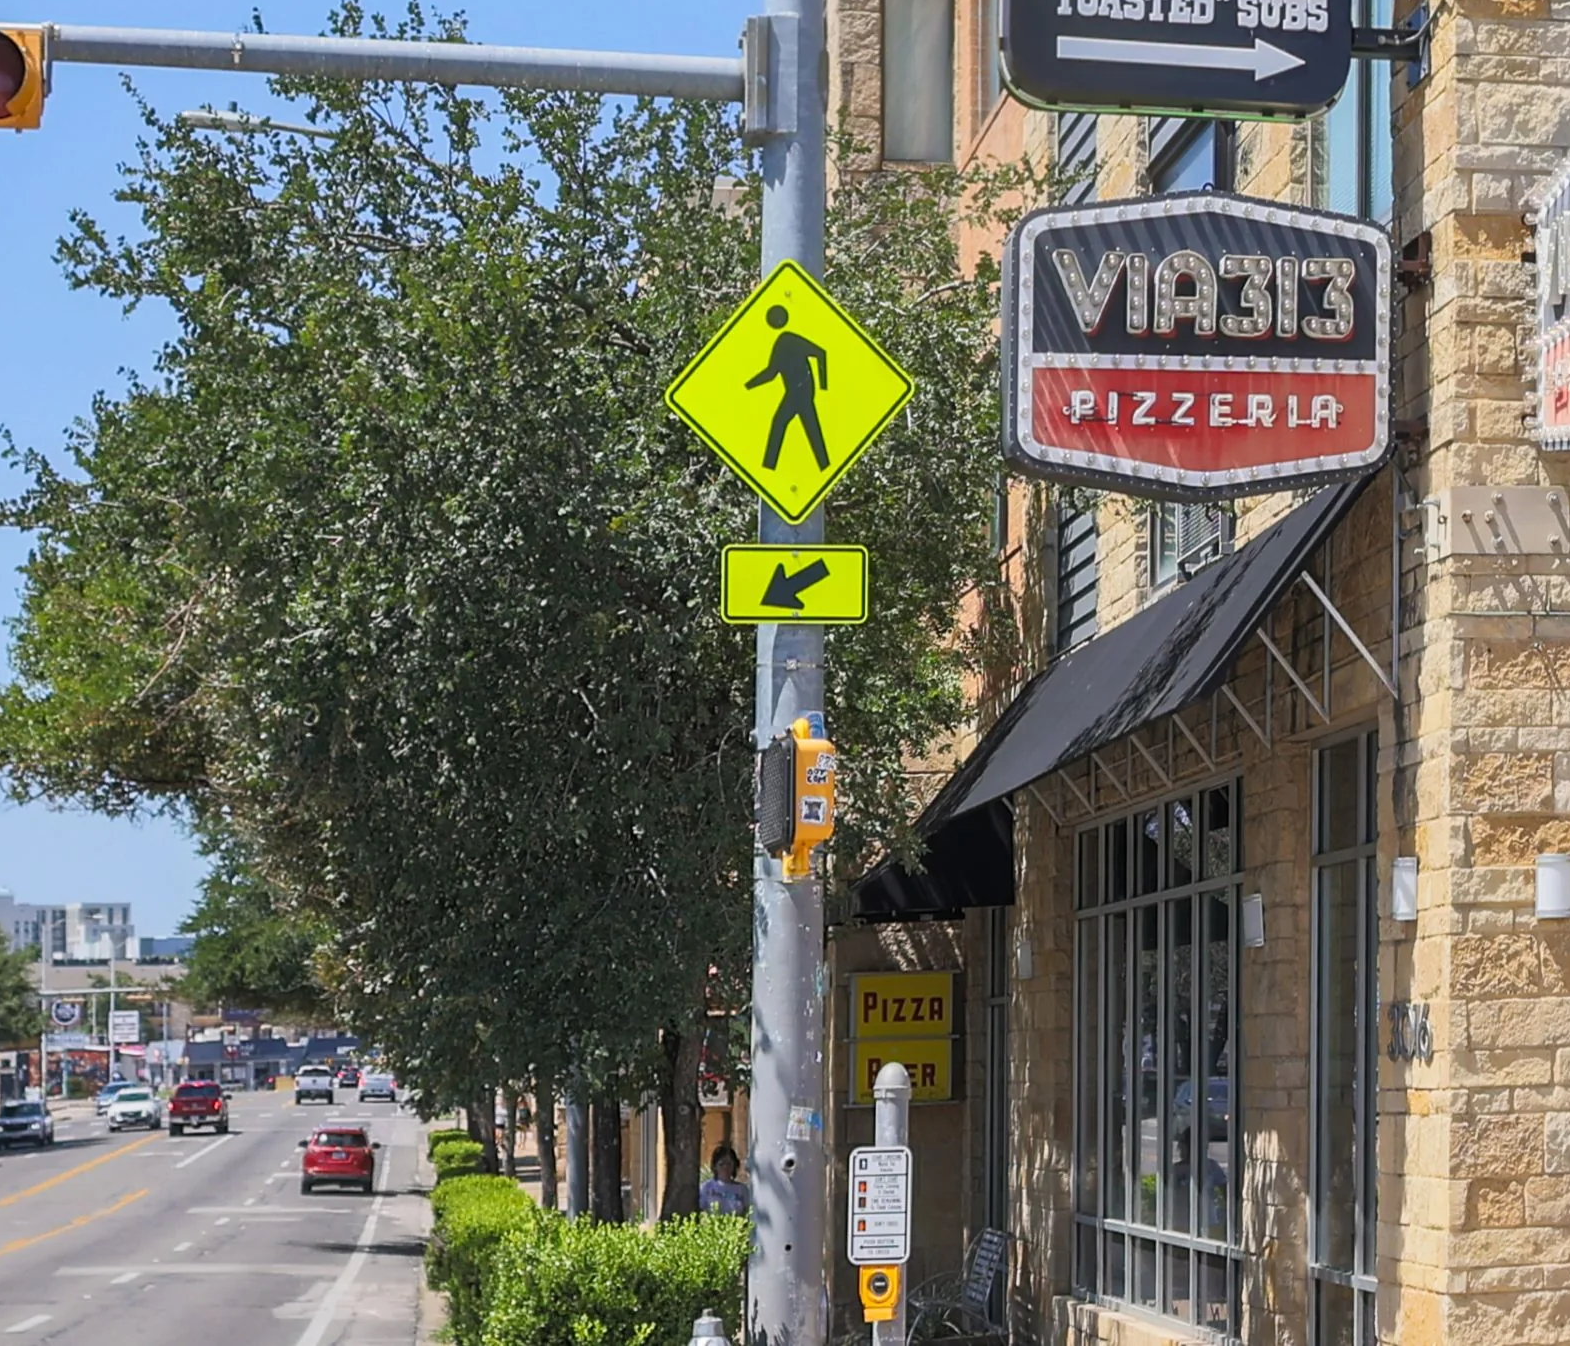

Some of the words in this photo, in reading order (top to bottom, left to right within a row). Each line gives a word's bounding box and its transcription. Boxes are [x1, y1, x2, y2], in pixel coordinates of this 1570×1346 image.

[1069, 389, 1338, 429] PIZZERIA
[863, 991, 944, 1024] PIZZA
[867, 1058, 936, 1090] BER
